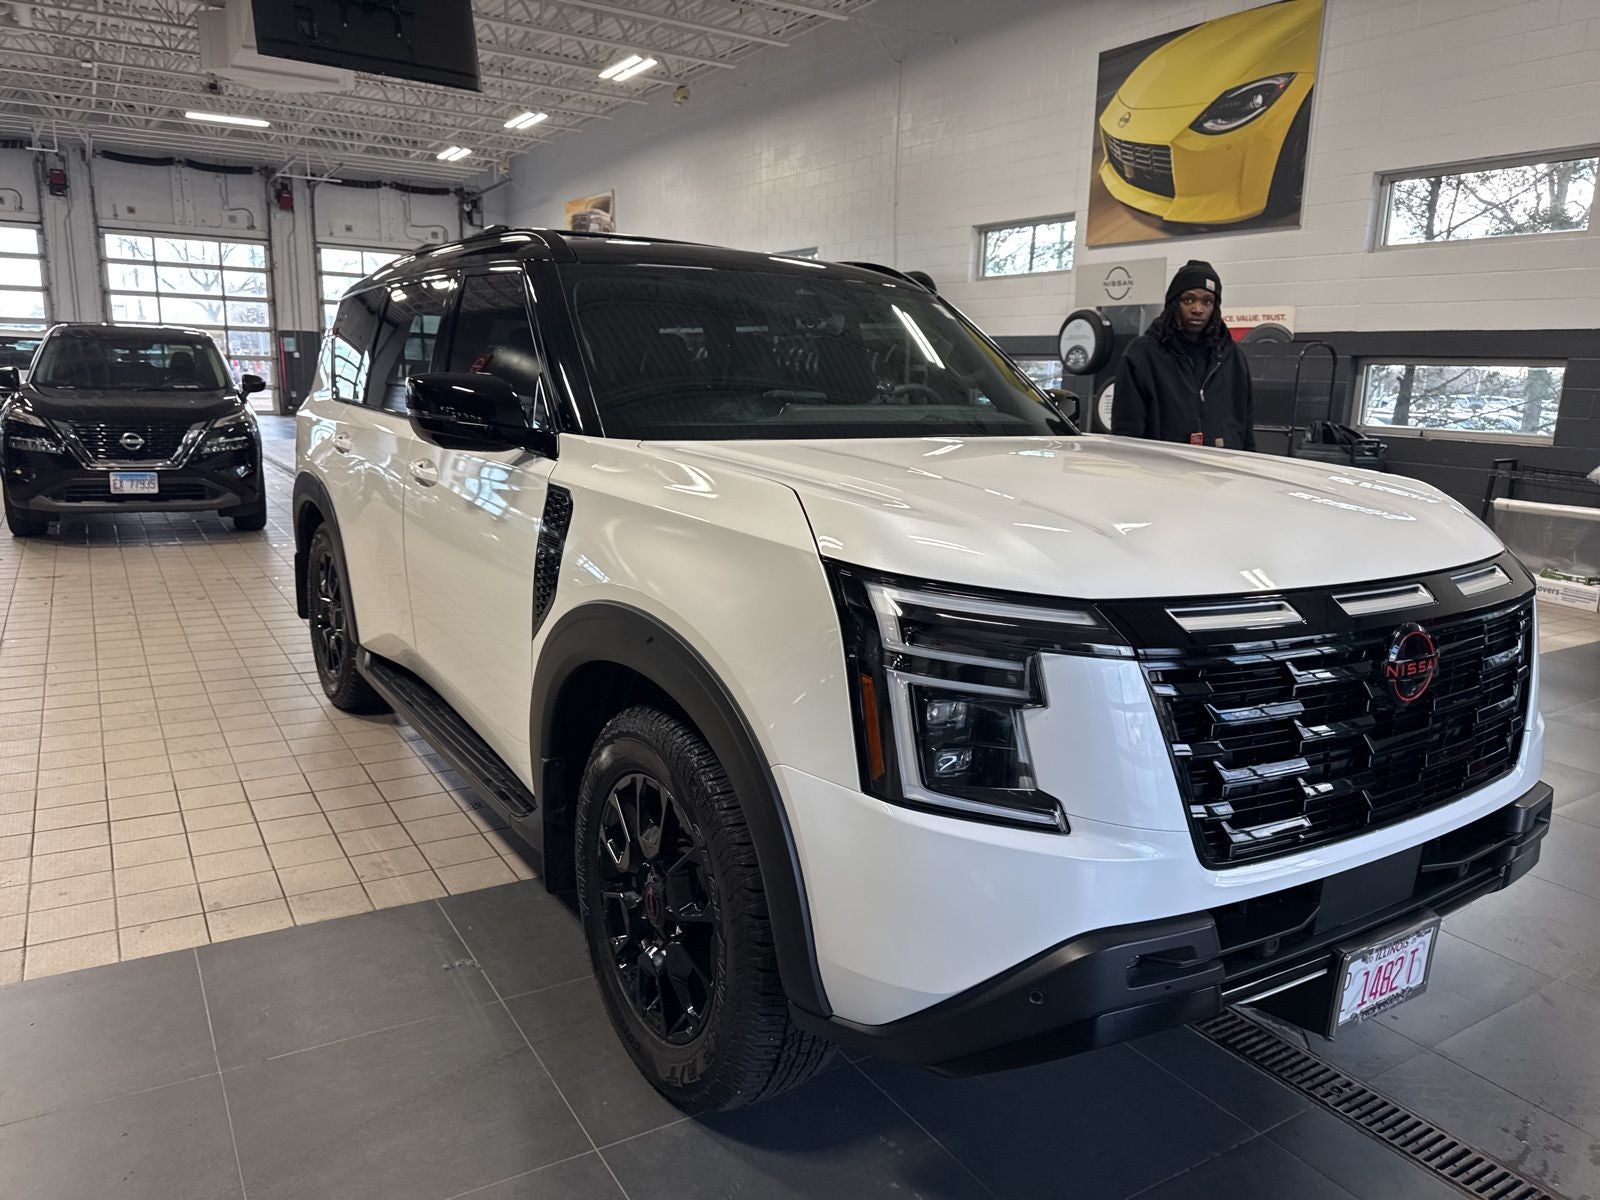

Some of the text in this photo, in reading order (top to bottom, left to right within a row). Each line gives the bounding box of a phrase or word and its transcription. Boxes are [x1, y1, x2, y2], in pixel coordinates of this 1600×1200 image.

[1262, 313, 1287, 321] TRUST.
[1536, 584, 1560, 596] overs
[1356, 955, 1405, 1008] 1482
